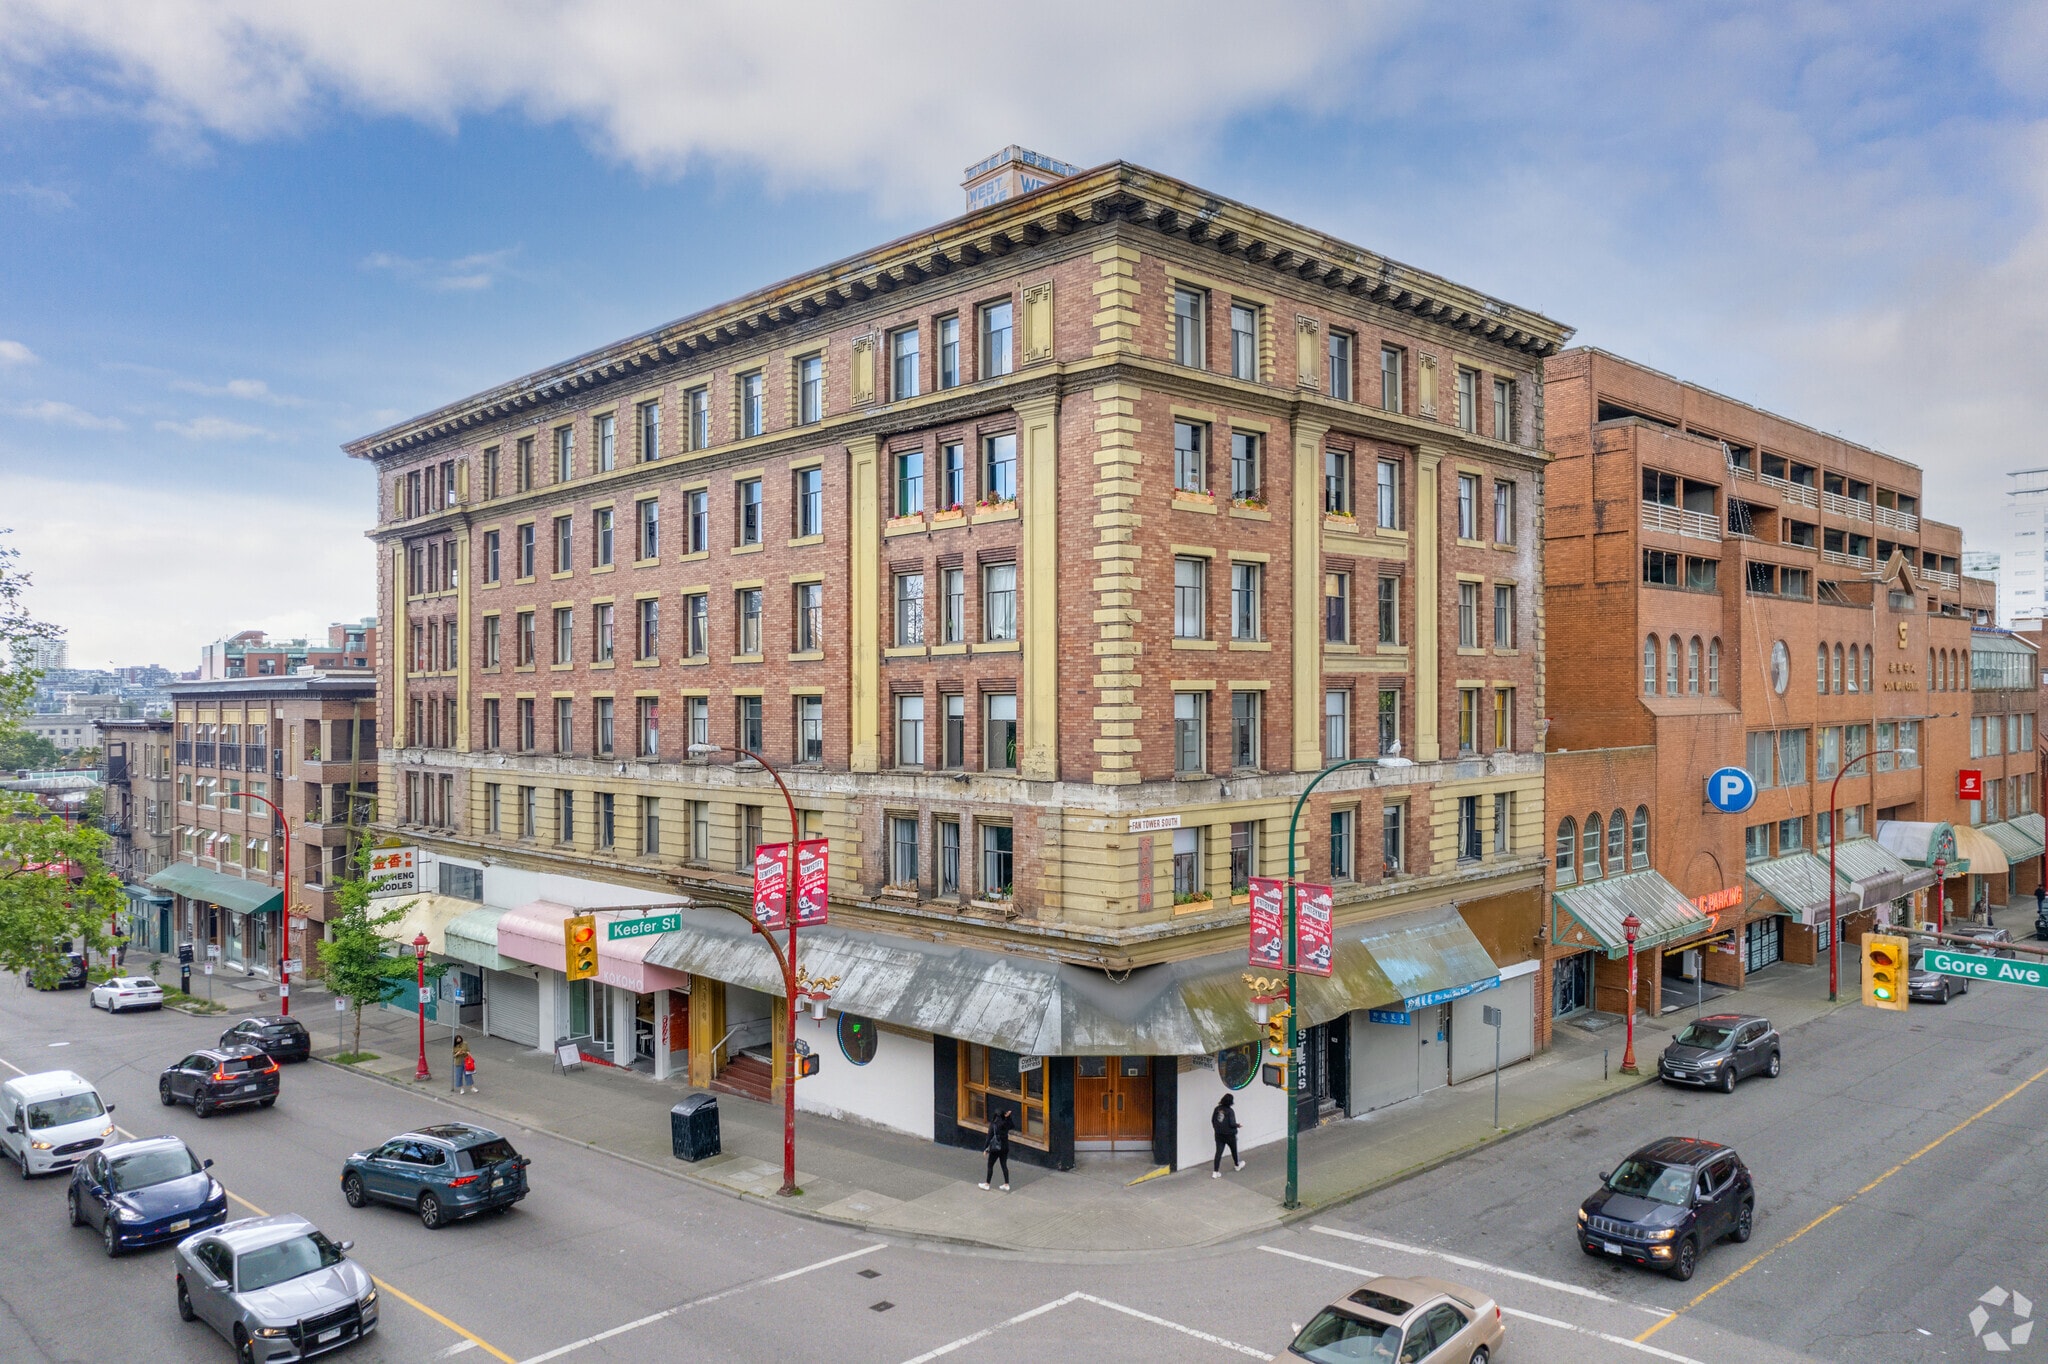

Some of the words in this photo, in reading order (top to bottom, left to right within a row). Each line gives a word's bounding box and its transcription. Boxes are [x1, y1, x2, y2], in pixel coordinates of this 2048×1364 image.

[970, 178, 1002, 203] WEST
[1720, 776, 1744, 804] P
[1142, 819, 1160, 828] TOWER
[1162, 818, 1178, 826] SOUTH
[760, 864, 781, 879] DEMYSTIFY
[802, 859, 822, 875] DEMYSTIFY
[1707, 886, 1742, 912] PARKING
[614, 922, 657, 936] Keefer
[662, 918, 676, 930] St
[1934, 955, 1988, 976] Gore
[1998, 963, 2040, 982] Ave
[604, 971, 642, 992] KOKOMO
